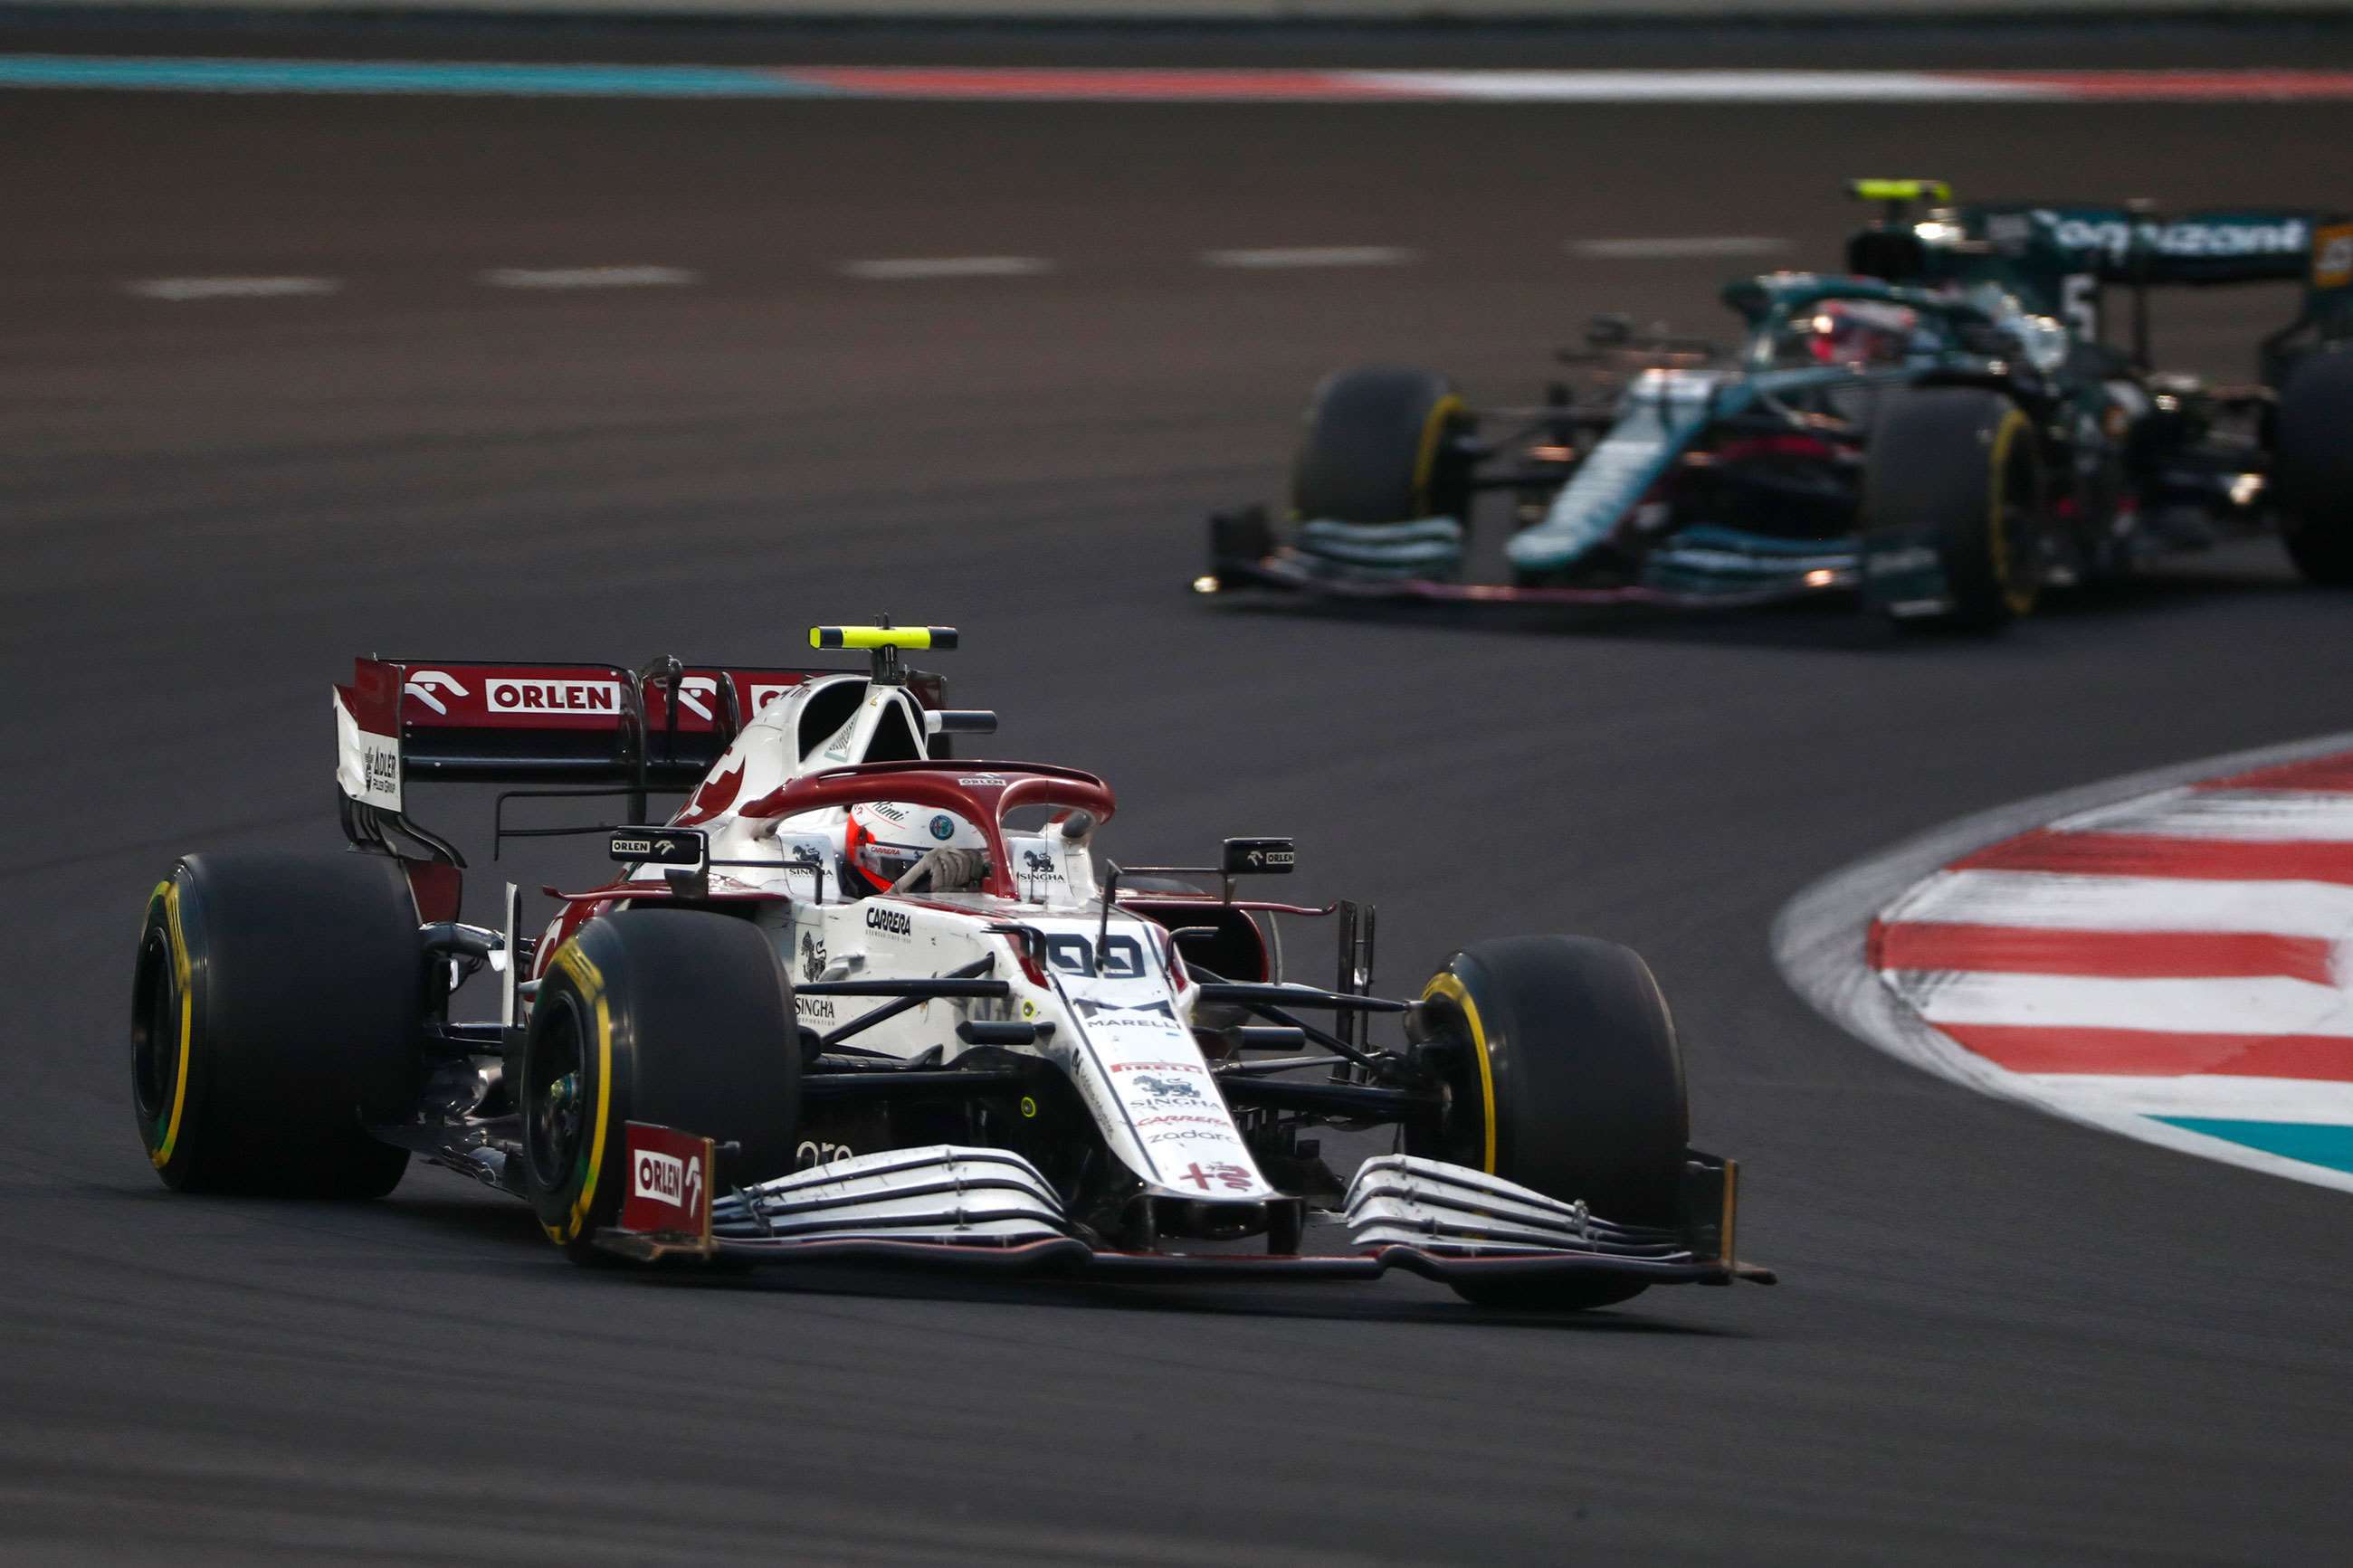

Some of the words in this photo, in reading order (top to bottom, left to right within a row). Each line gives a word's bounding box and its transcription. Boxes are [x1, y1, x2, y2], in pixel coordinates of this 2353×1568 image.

[494, 684, 613, 709] ORLEN
[614, 841, 648, 851] ORLEN
[1268, 854, 1293, 862] ORLEN
[866, 908, 910, 936] CARRERA
[795, 998, 834, 1018] SINGHA
[1088, 1020, 1181, 1030] MARELLI
[1130, 1098, 1222, 1109] SINGHA
[1137, 1116, 1233, 1127] CARRERA
[640, 1157, 679, 1198] ORLEN
